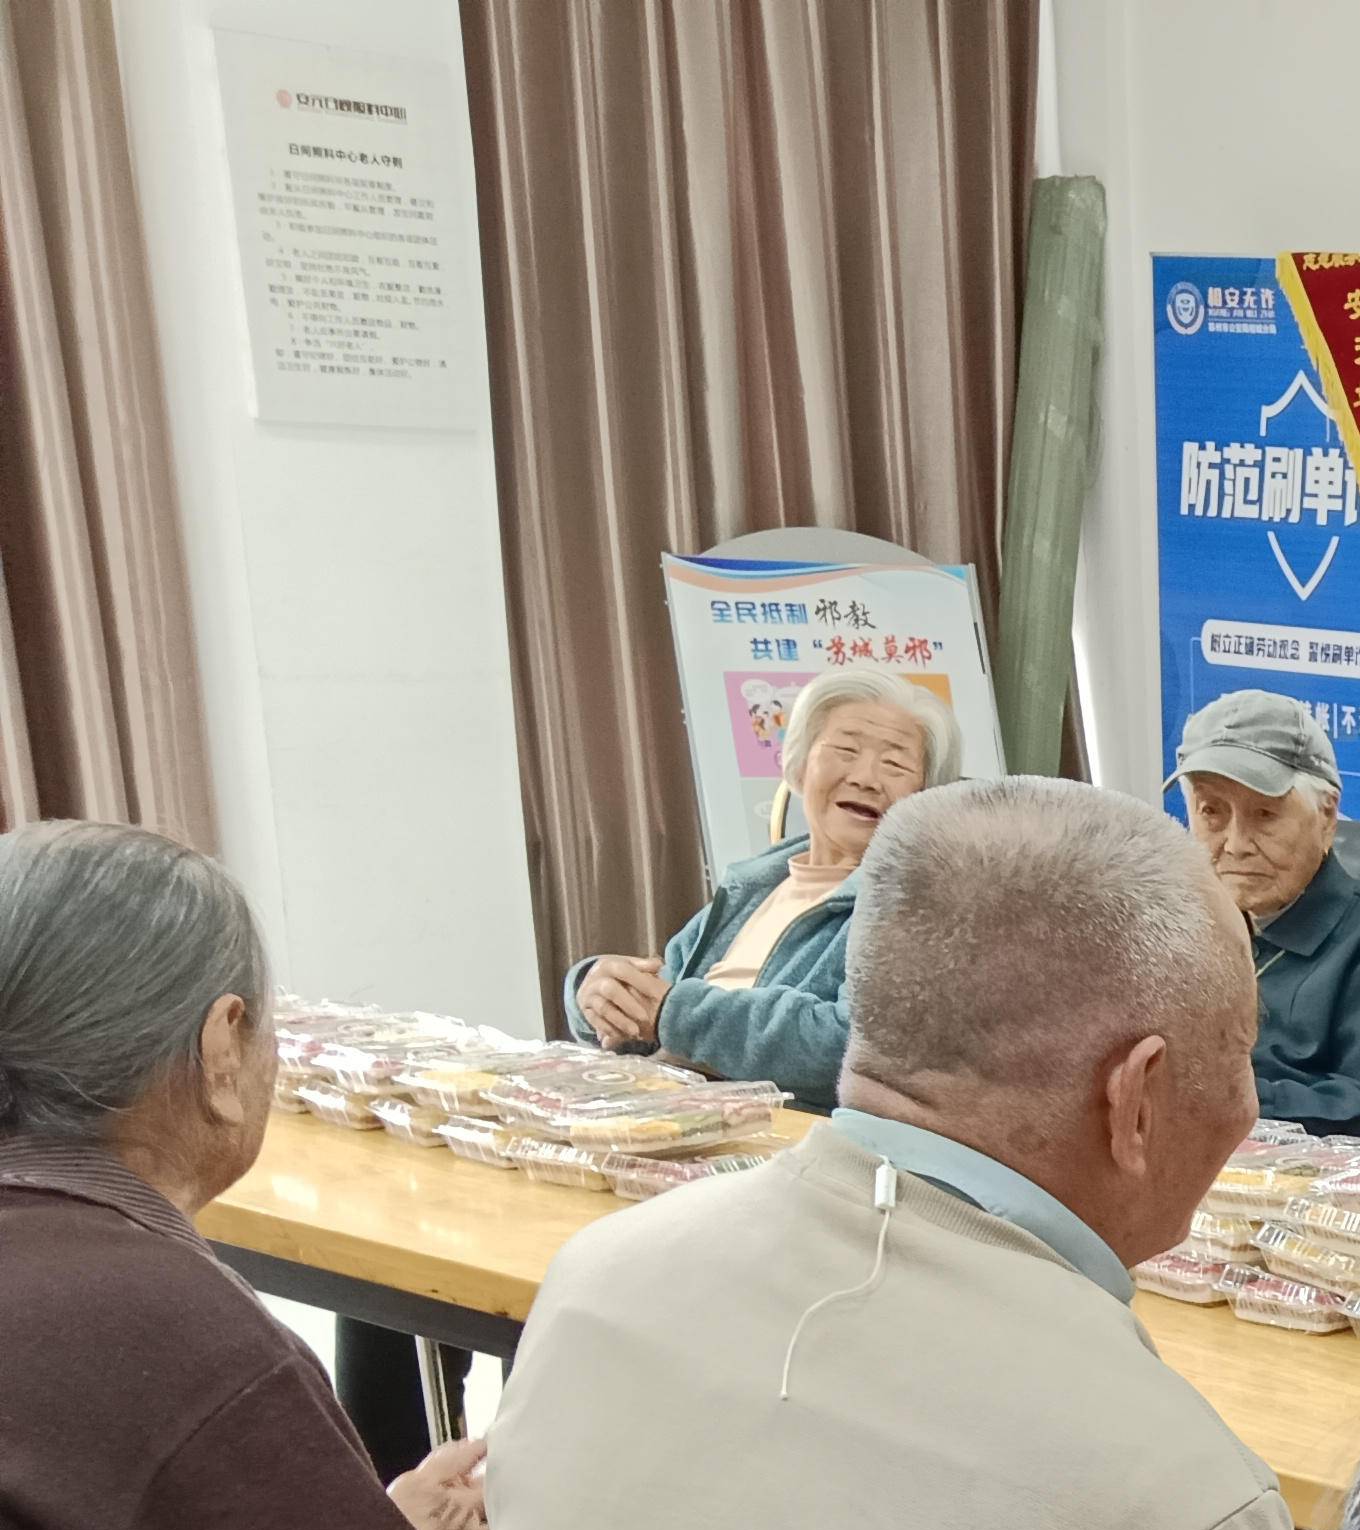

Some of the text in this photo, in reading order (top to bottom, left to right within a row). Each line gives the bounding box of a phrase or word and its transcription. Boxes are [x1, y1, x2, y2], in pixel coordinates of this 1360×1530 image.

[1210, 632, 1300, 661] 树立正确劳动观念
